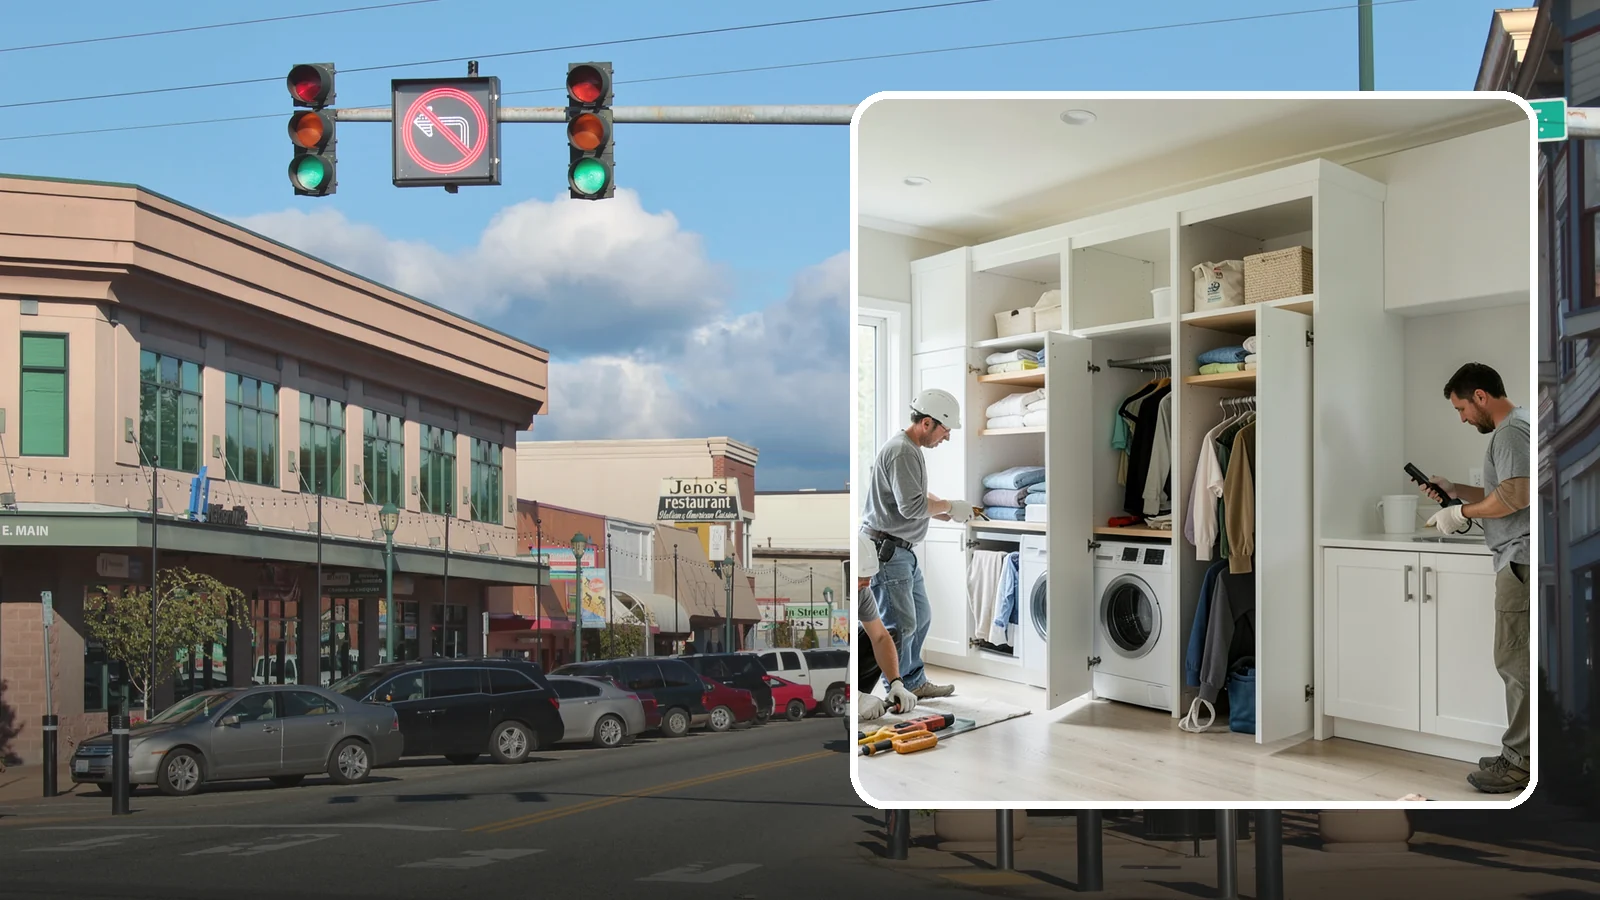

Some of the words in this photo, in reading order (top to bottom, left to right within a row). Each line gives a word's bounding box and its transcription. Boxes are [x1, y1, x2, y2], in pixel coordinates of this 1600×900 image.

[670, 480, 727, 494] Jeno's
[665, 496, 731, 509] restaurant
[659, 509, 682, 520] Italian
[686, 509, 714, 520] American
[715, 509, 738, 519] Cuisine
[2, 525, 13, 536] E.
[15, 525, 49, 536] MAIN
[785, 607, 795, 617] in
[797, 607, 829, 617] Street
[791, 619, 824, 628] lass
